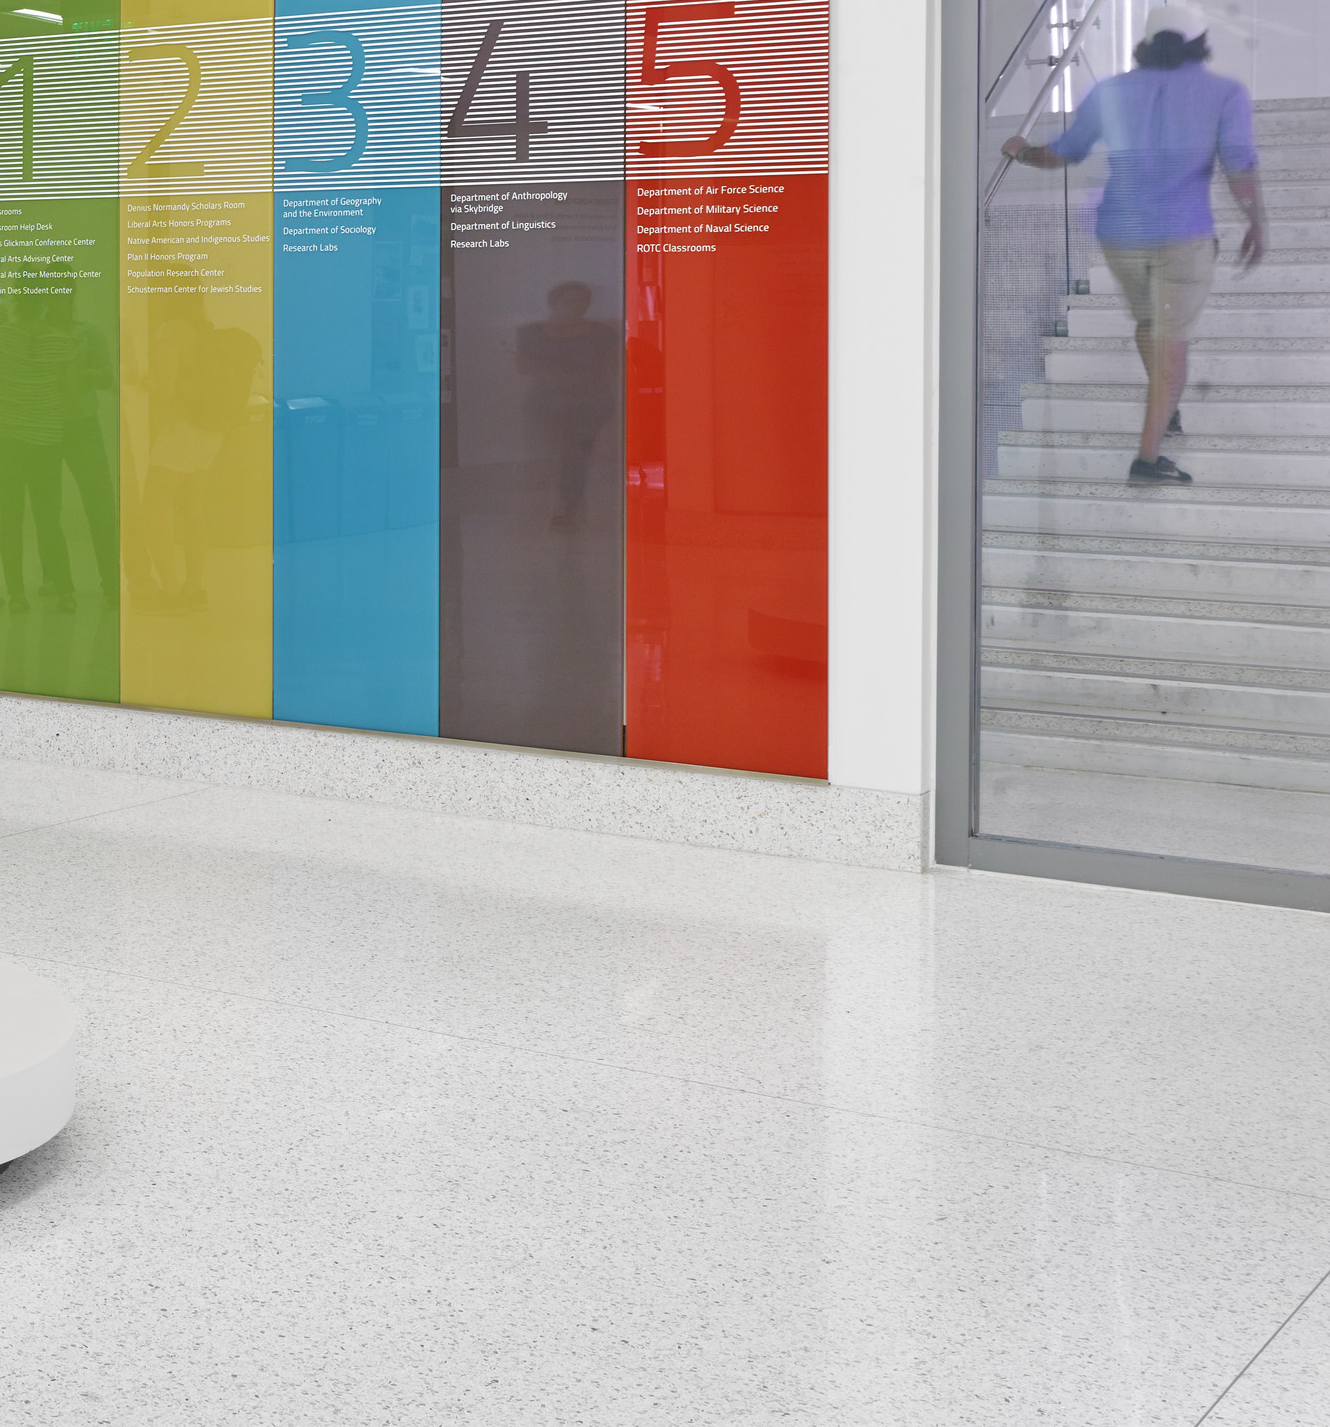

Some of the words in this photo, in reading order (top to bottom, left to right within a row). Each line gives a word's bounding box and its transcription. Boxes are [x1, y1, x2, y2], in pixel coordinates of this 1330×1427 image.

[639, 1, 741, 156] 5
[446, 22, 548, 163] 4
[283, 29, 369, 173] 3
[126, 43, 204, 178] 2
[637, 187, 691, 198] Department
[694, 186, 703, 195] of
[705, 186, 718, 194] Air
[720, 185, 747, 194] Force
[749, 184, 785, 194] Science
[450, 193, 499, 204] Department
[501, 192, 510, 200] of
[511, 190, 568, 201] Anthropology
[127, 204, 151, 212] Denius
[153, 203, 190, 211] Normandy
[191, 202, 222, 210] Scholars
[283, 199, 329, 208] Department
[340, 197, 382, 207] Geography
[283, 210, 297, 218] and
[299, 209, 312, 217] the
[313, 209, 364, 217] Environment
[450, 205, 462, 213] via
[464, 204, 504, 214] Skybridge
[637, 206, 691, 217] Department
[694, 205, 703, 214] of
[705, 205, 741, 215] Military
[743, 204, 779, 213] Science
[20, 224, 35, 232] Help
[196, 219, 231, 228] Programs
[450, 222, 499, 232] Department
[501, 221, 510, 229] of
[511, 220, 556, 231] Linguistics
[283, 227, 329, 236] Department
[330, 226, 339, 234] of
[340, 225, 376, 235] Sociology
[637, 225, 691, 235] Department
[693, 224, 703, 233] of
[705, 224, 732, 233] Naval
[734, 223, 770, 232] Science
[3, 239, 33, 247] Glickman
[151, 236, 184, 244] American
[201, 235, 241, 245] Indigenous
[242, 234, 270, 242] Studies
[450, 239, 488, 248] Research
[489, 239, 510, 248] Labs
[283, 244, 318, 252] Research
[637, 244, 661, 253] ROTC
[662, 243, 717, 252] Classrooms
[22, 255, 51, 264] Advising
[177, 253, 208, 262] Program
[39, 271, 78, 279] Mentorship
[78, 270, 101, 278] Center
[127, 269, 165, 278] Population
[166, 269, 199, 277] Research
[127, 285, 172, 293] Schusterman
[173, 285, 197, 293] Center
[198, 285, 208, 293] for
[210, 285, 233, 293] Jewish
